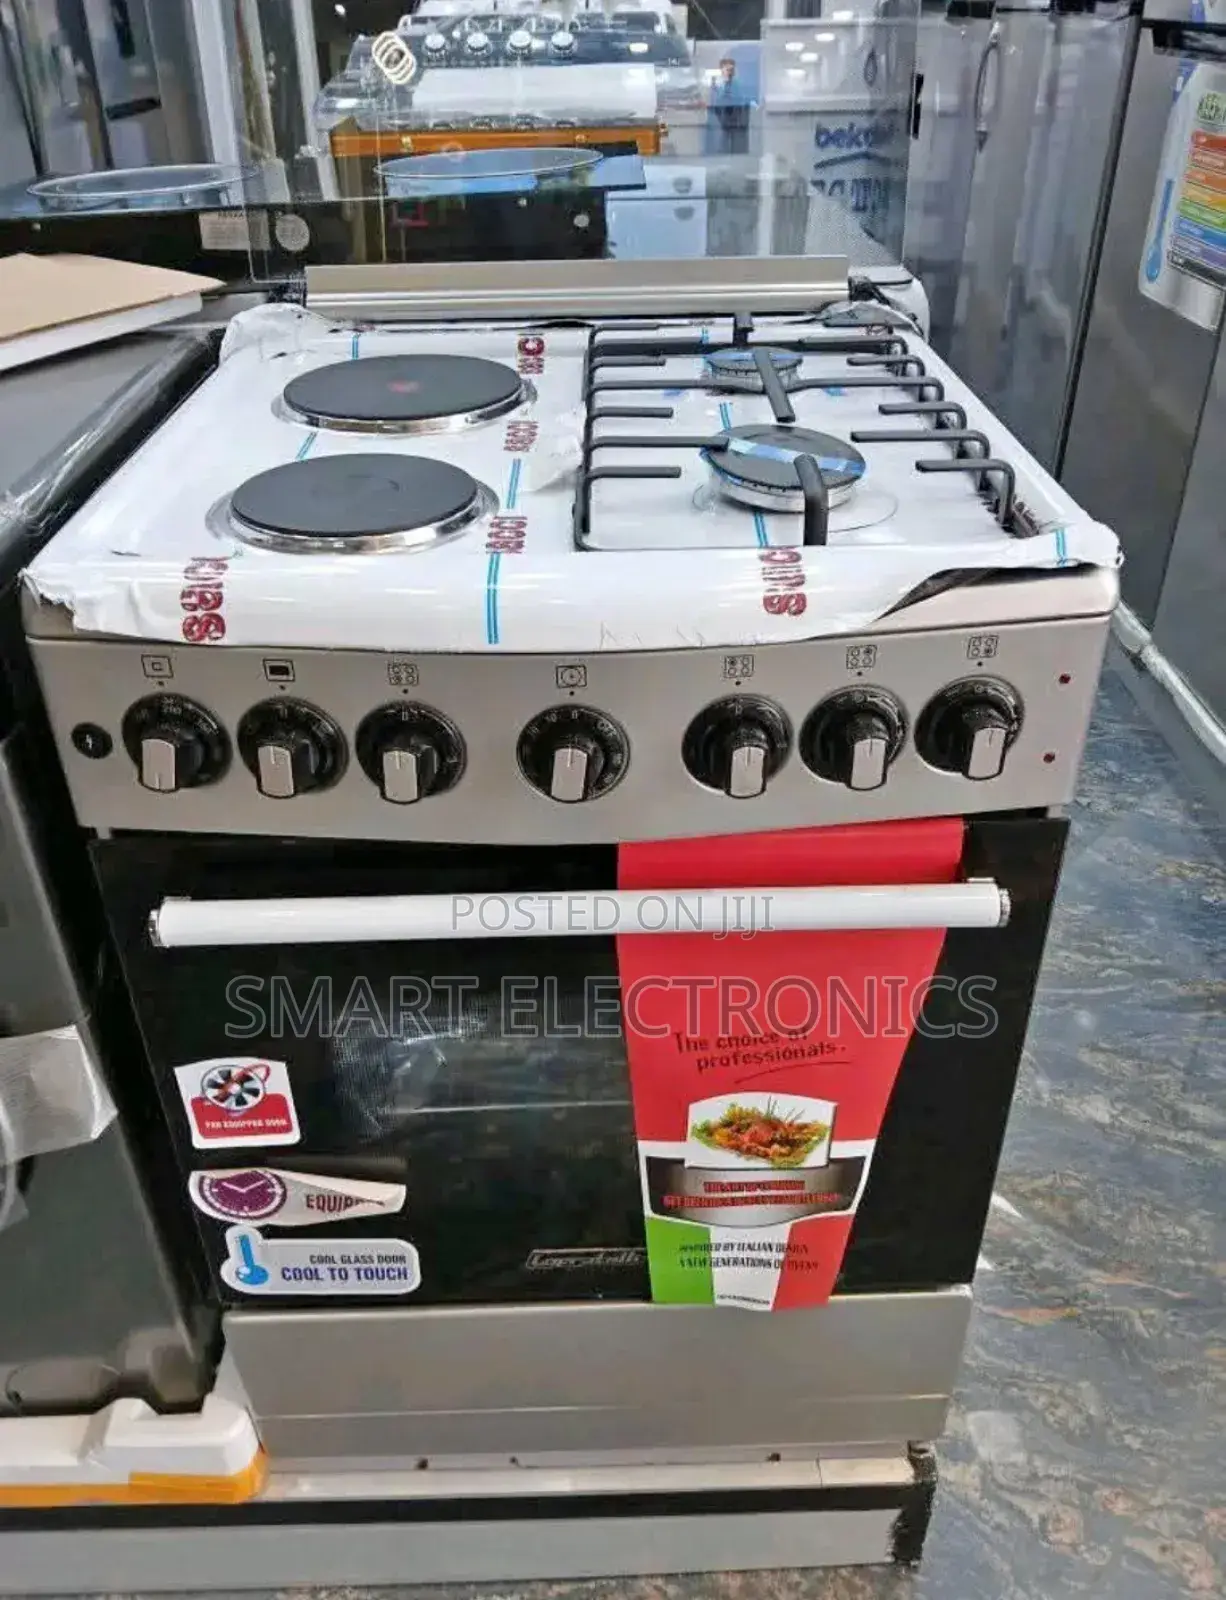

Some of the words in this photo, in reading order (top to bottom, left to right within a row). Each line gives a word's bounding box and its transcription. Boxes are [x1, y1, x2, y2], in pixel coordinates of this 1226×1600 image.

[674, 1031, 708, 1054] The
[715, 1031, 780, 1050] choice
[309, 1254, 337, 1265] COOL
[340, 1254, 374, 1265] GLASS
[281, 1266, 325, 1282] COOL
[326, 1266, 349, 1282] TO
[354, 1266, 409, 1281] TOUCH
